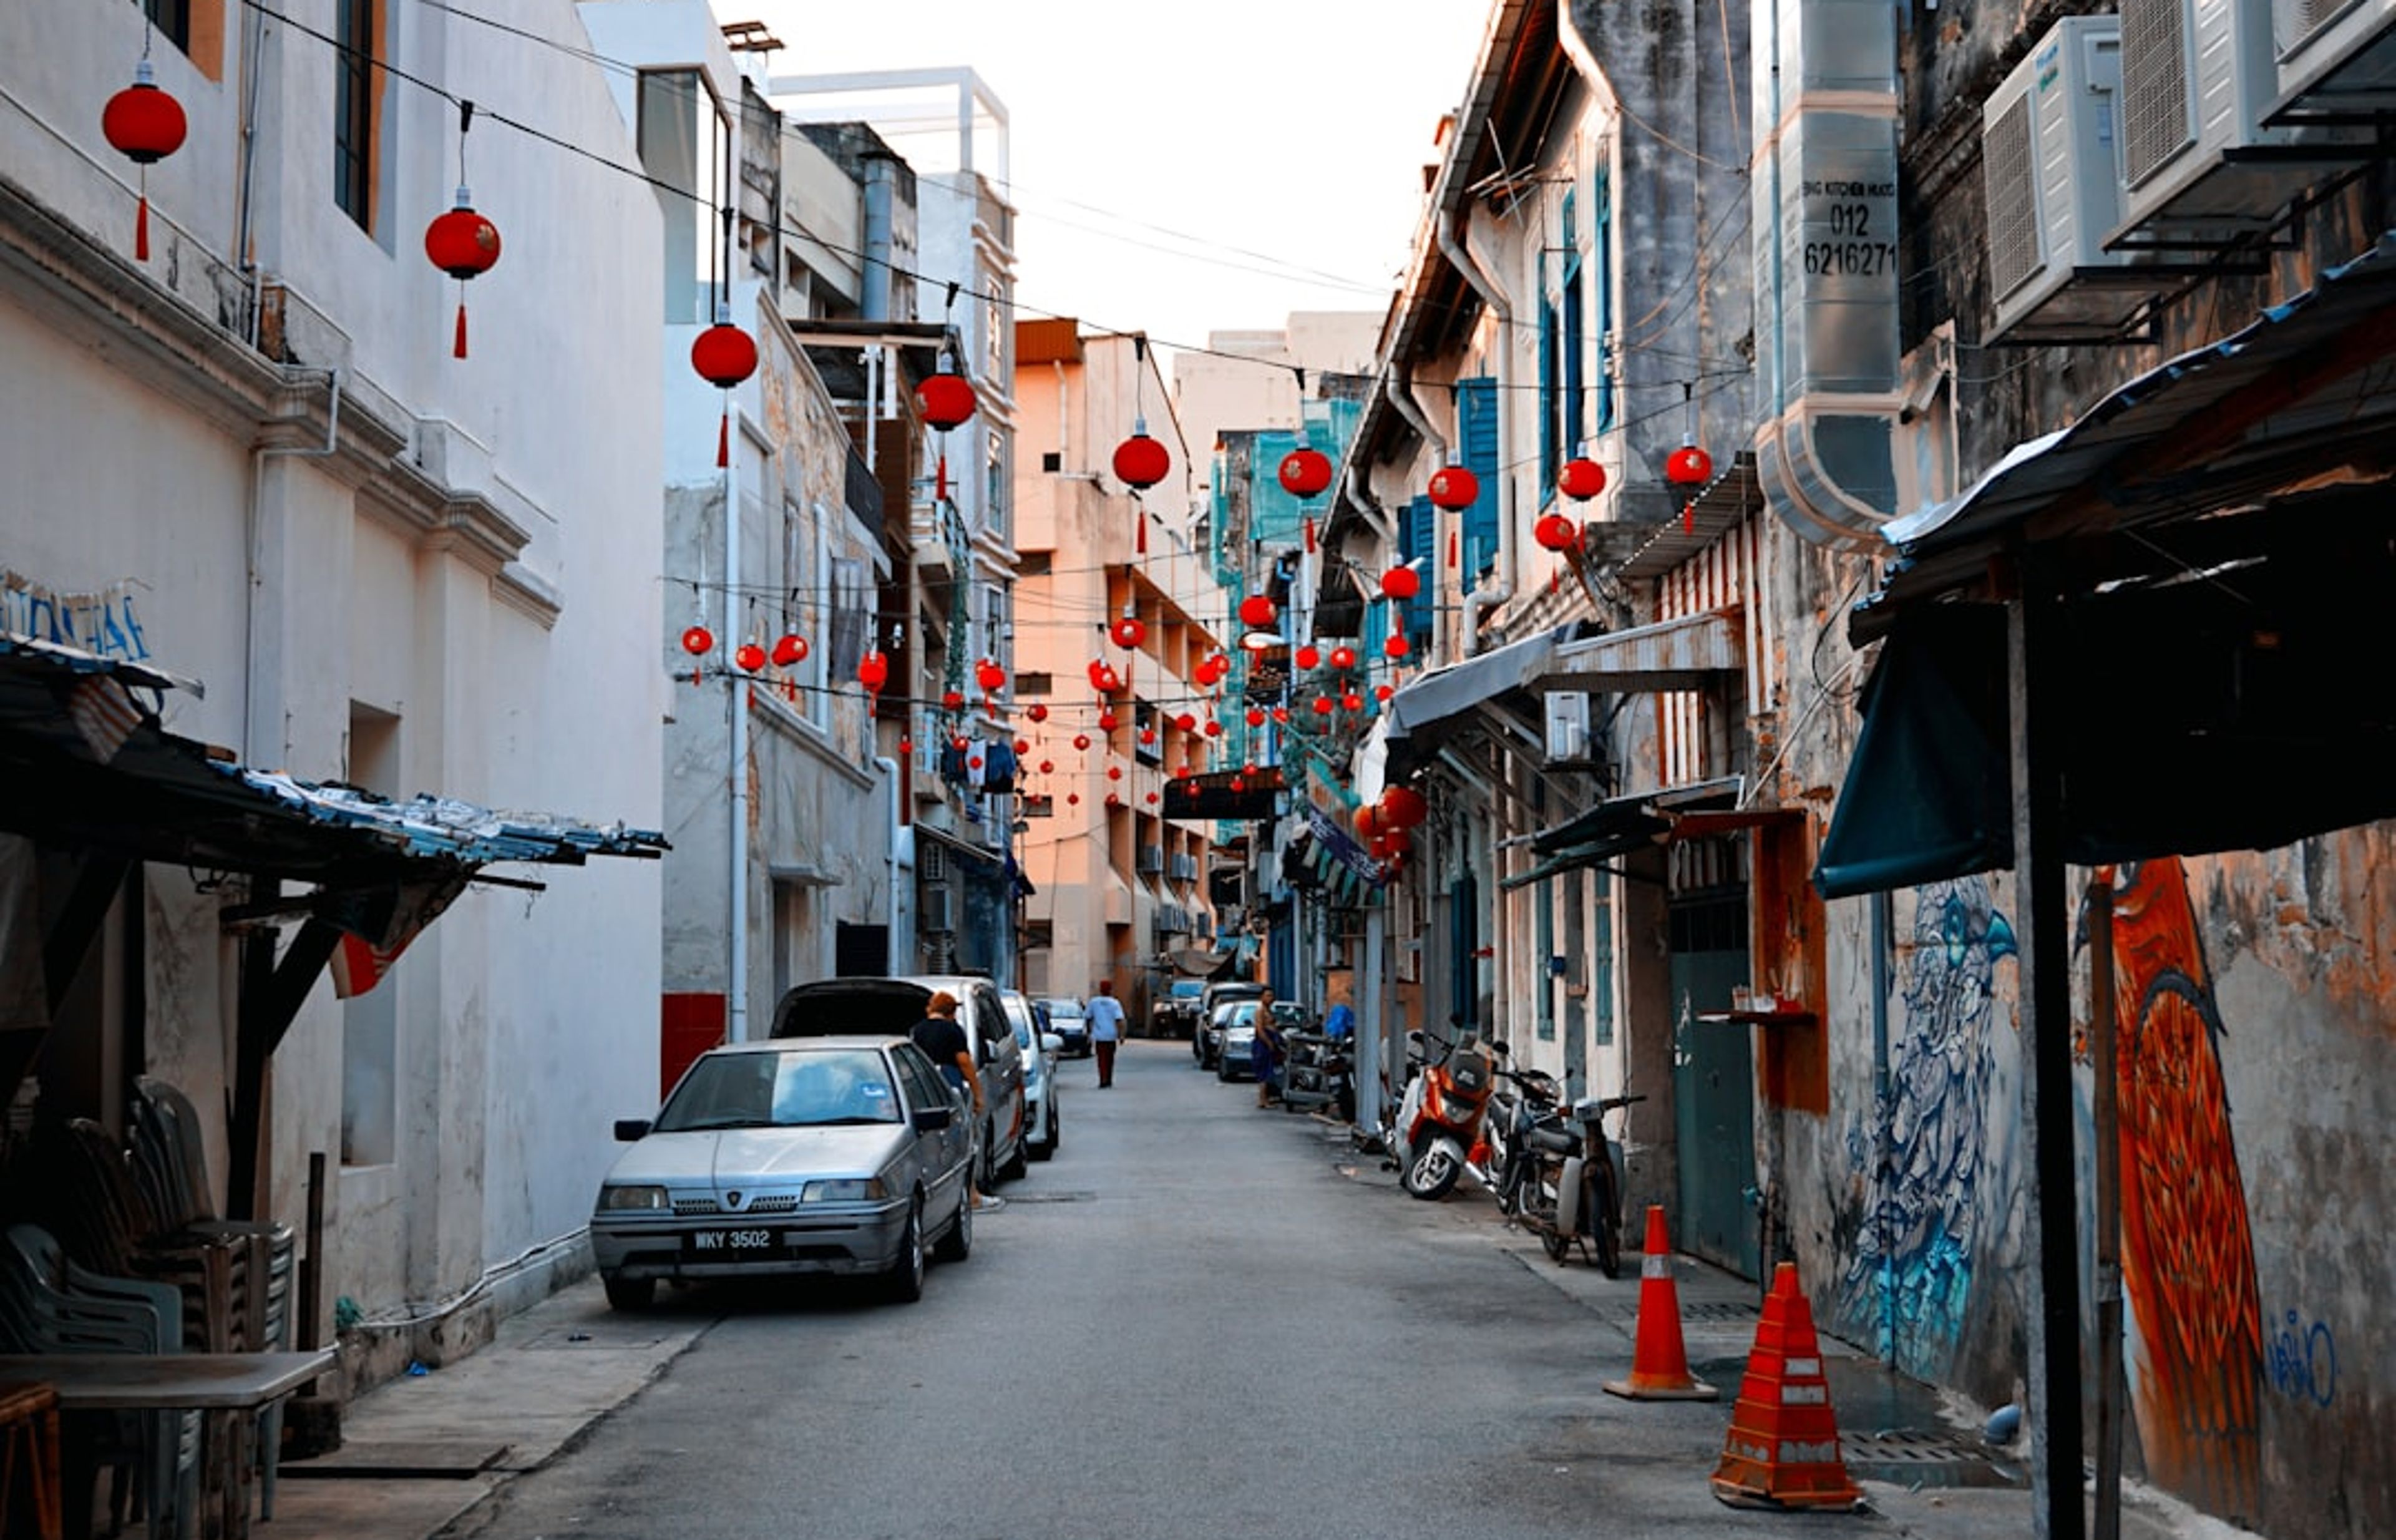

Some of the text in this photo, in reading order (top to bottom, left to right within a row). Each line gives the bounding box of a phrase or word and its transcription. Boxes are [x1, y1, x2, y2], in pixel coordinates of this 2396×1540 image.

[1831, 204, 1869, 236] 012
[1805, 242, 1895, 276] 6216271
[694, 1229, 770, 1249] WKY 3502
